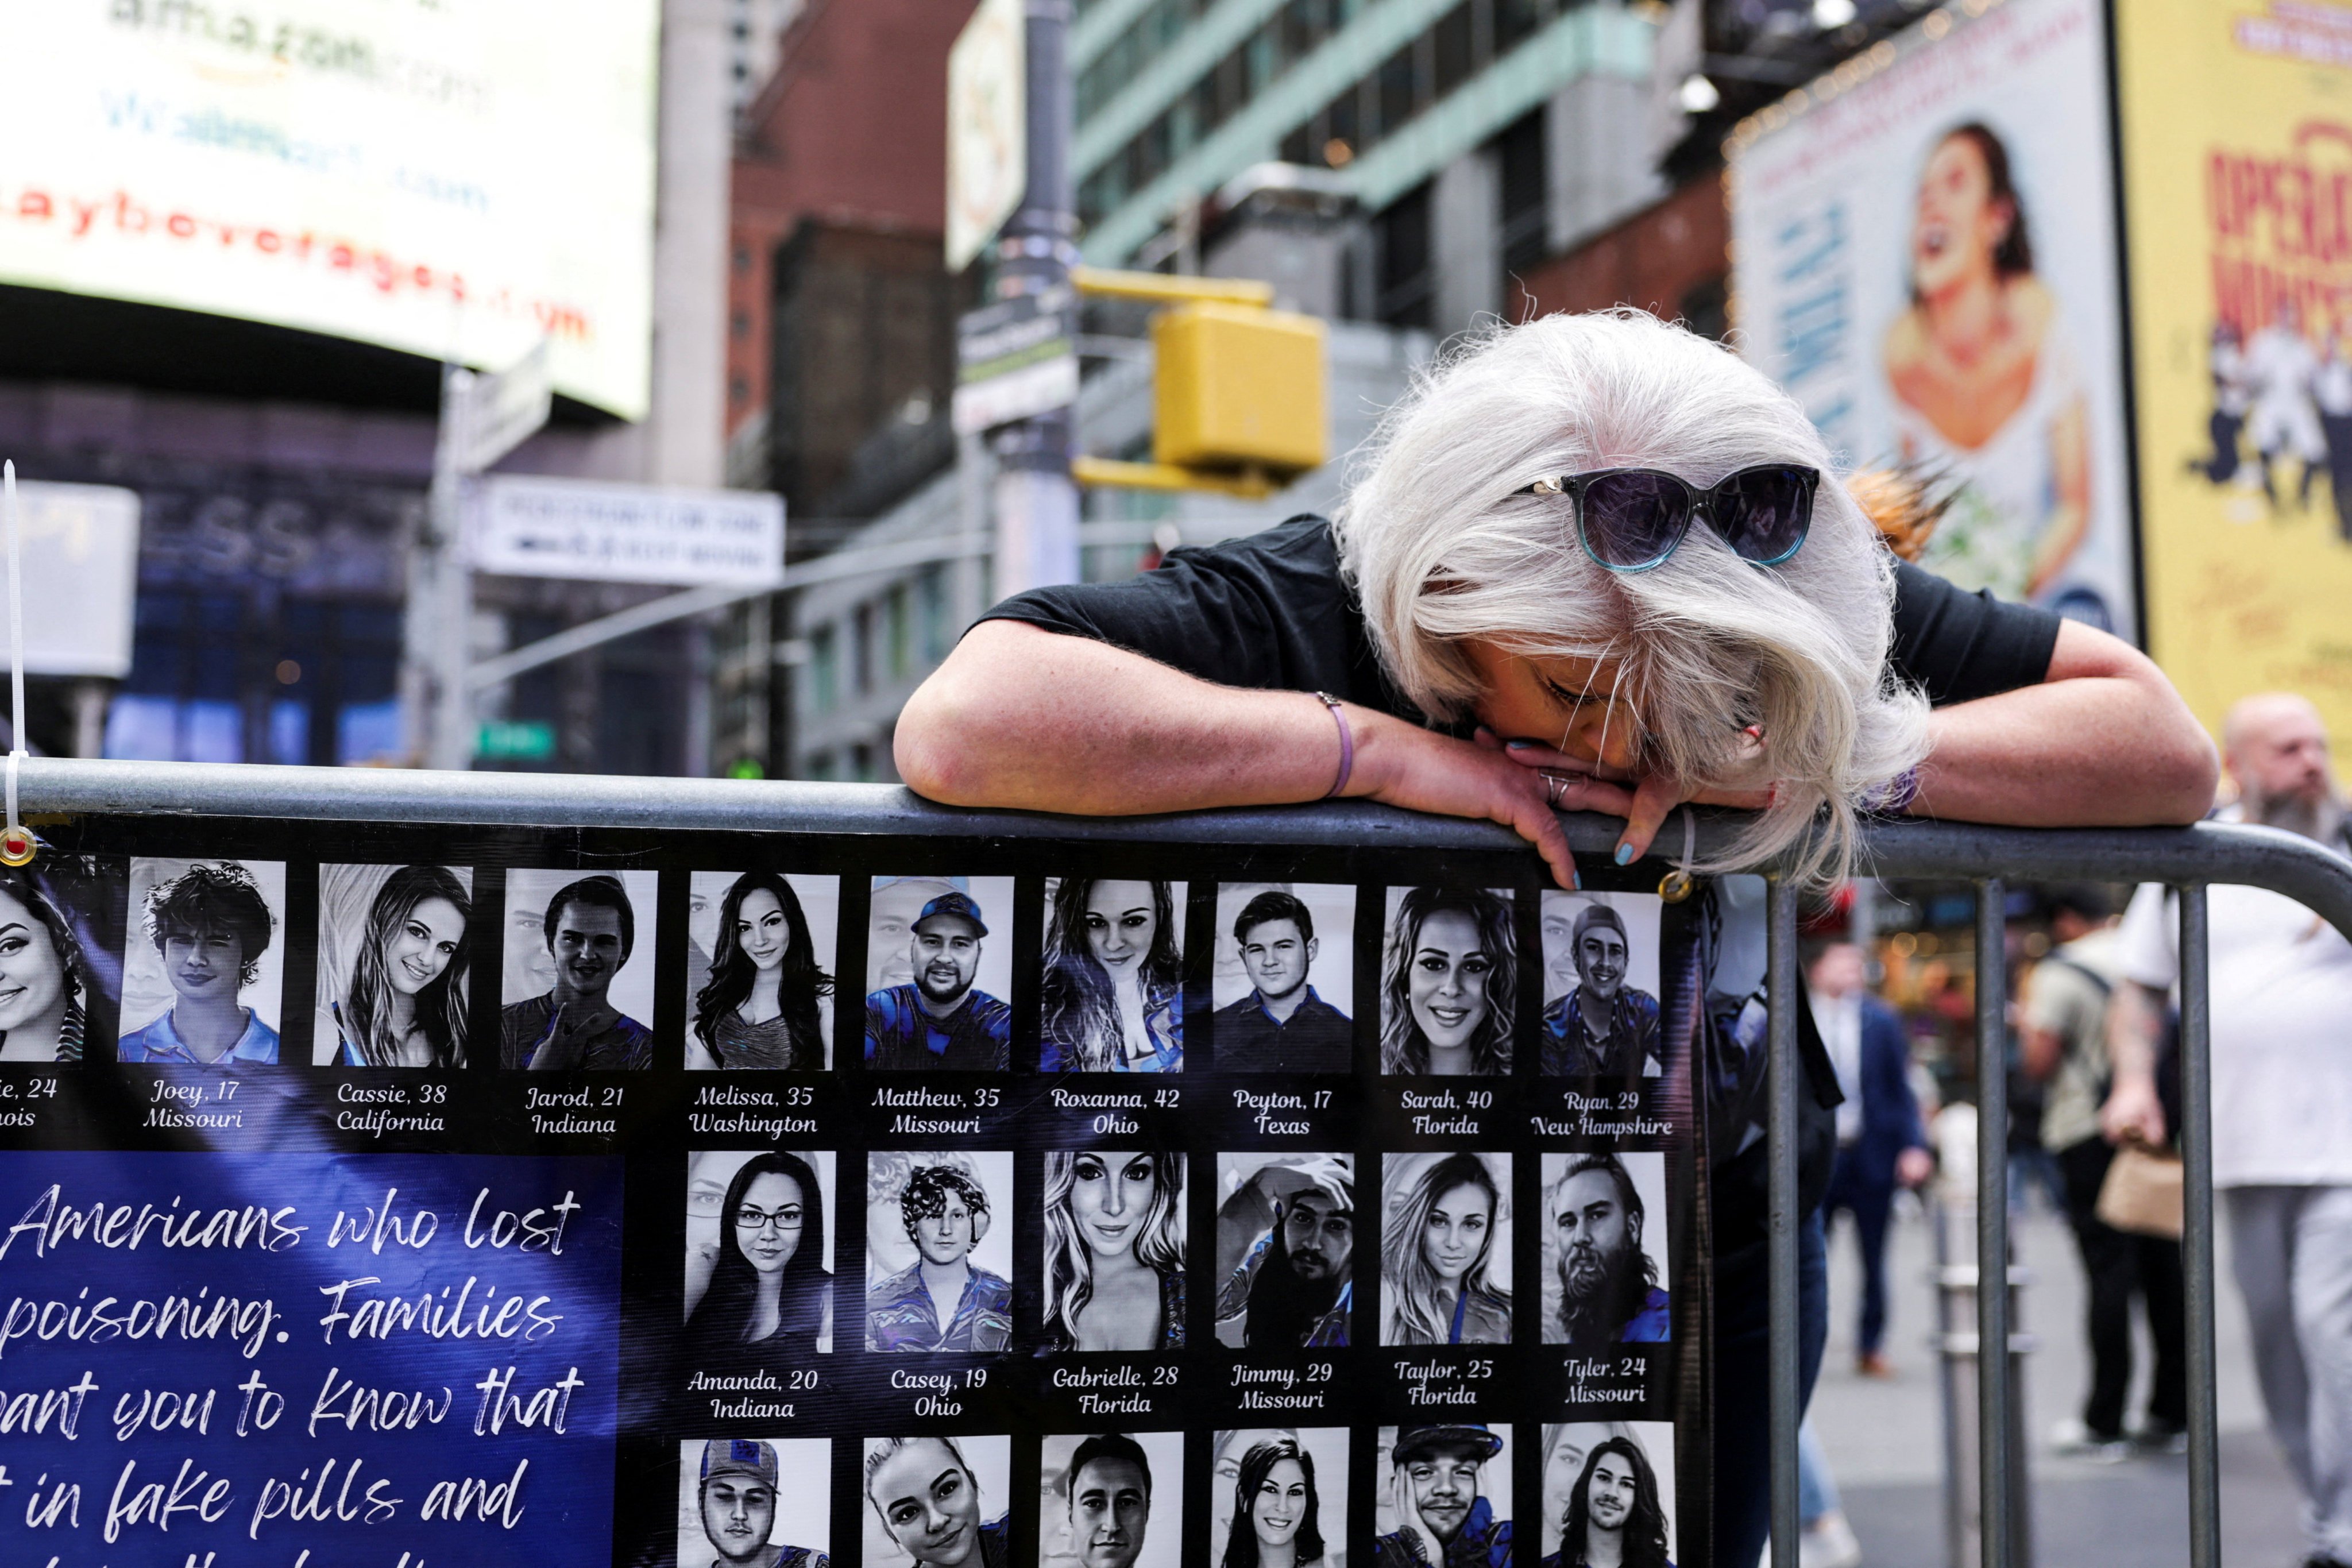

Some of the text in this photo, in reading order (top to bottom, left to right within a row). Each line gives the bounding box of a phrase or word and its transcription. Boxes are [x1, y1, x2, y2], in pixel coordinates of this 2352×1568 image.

[27, 1079, 57, 1098] 24
[150, 1080, 240, 1108] Joey, 17
[338, 1083, 447, 1104] Cassie, 38
[525, 1086, 623, 1110] Jarod, 21
[694, 1085, 814, 1107] Melissa, 35
[871, 1086, 1001, 1108] Matthew, 35
[1051, 1088, 1180, 1109] Roxanna, 42
[1401, 1089, 1492, 1110] Sarah, 40
[1233, 1090, 1332, 1116] Peyton, 17
[1563, 1092, 1639, 1118] Ryan, 29
[142, 1107, 243, 1128] Missouri
[337, 1109, 445, 1138] California
[531, 1113, 617, 1133] Indiana
[689, 1113, 817, 1141] Washington
[889, 1114, 981, 1133] Missouri
[1093, 1114, 1140, 1134] Ohio
[1253, 1115, 1310, 1134] Texas
[1412, 1114, 1479, 1134] Florida
[1530, 1116, 1673, 1142] New Hampshire
[0, 1184, 581, 1260] Americans who lost
[0, 1276, 564, 1359] poisoning. Families
[687, 1369, 818, 1392] Amanda, 20
[1053, 1365, 1179, 1387] Gabrielle, 28
[1231, 1364, 1333, 1389] Jimmy, 29
[1394, 1359, 1493, 1387] Taylor, 25
[1564, 1357, 1647, 1385] Tyler, 24
[891, 1369, 987, 1396] Casey, 19
[113, 1388, 216, 1442] you
[237, 1369, 284, 1437] to
[474, 1366, 585, 1436] that
[914, 1395, 964, 1416] Ohio
[1078, 1392, 1152, 1414] Florida
[1238, 1391, 1324, 1409] Missouri
[1408, 1385, 1477, 1405] Florida
[1565, 1385, 1646, 1404] Missouri
[710, 1397, 795, 1418] Indiana
[26, 1458, 529, 1543] in fake pills and
